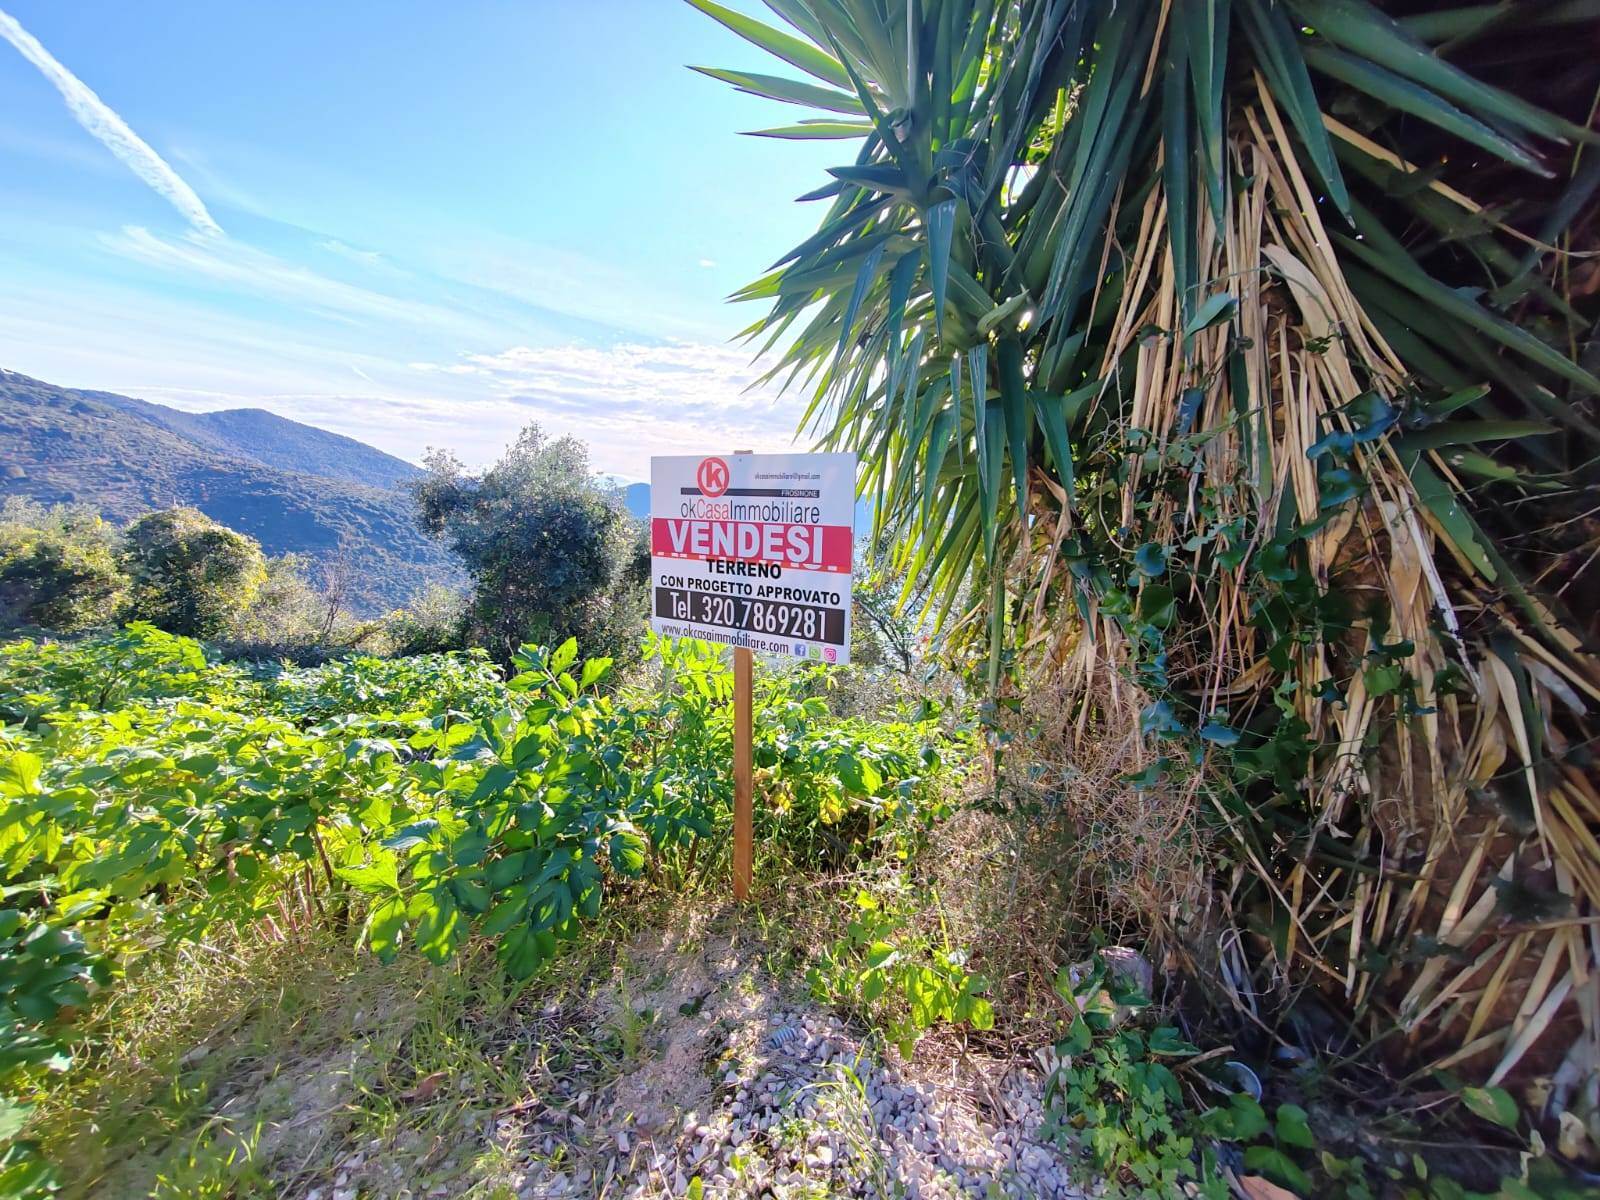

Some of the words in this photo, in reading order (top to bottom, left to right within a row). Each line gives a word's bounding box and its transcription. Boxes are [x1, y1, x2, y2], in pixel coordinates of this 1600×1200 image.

[781, 489, 818, 498] FROSINONE
[680, 499, 820, 524] okCasaImmobiliare
[667, 519, 823, 563] VENDESI
[706, 559, 782, 579] TERRENO
[660, 574, 684, 588] CON
[687, 578, 753, 595] PROGETTO
[756, 585, 841, 606] APPROVATO
[670, 591, 696, 620] Tel.
[702, 596, 826, 640] 320.7869281
[661, 624, 789, 654] www.okcasaimmobiliare.com
